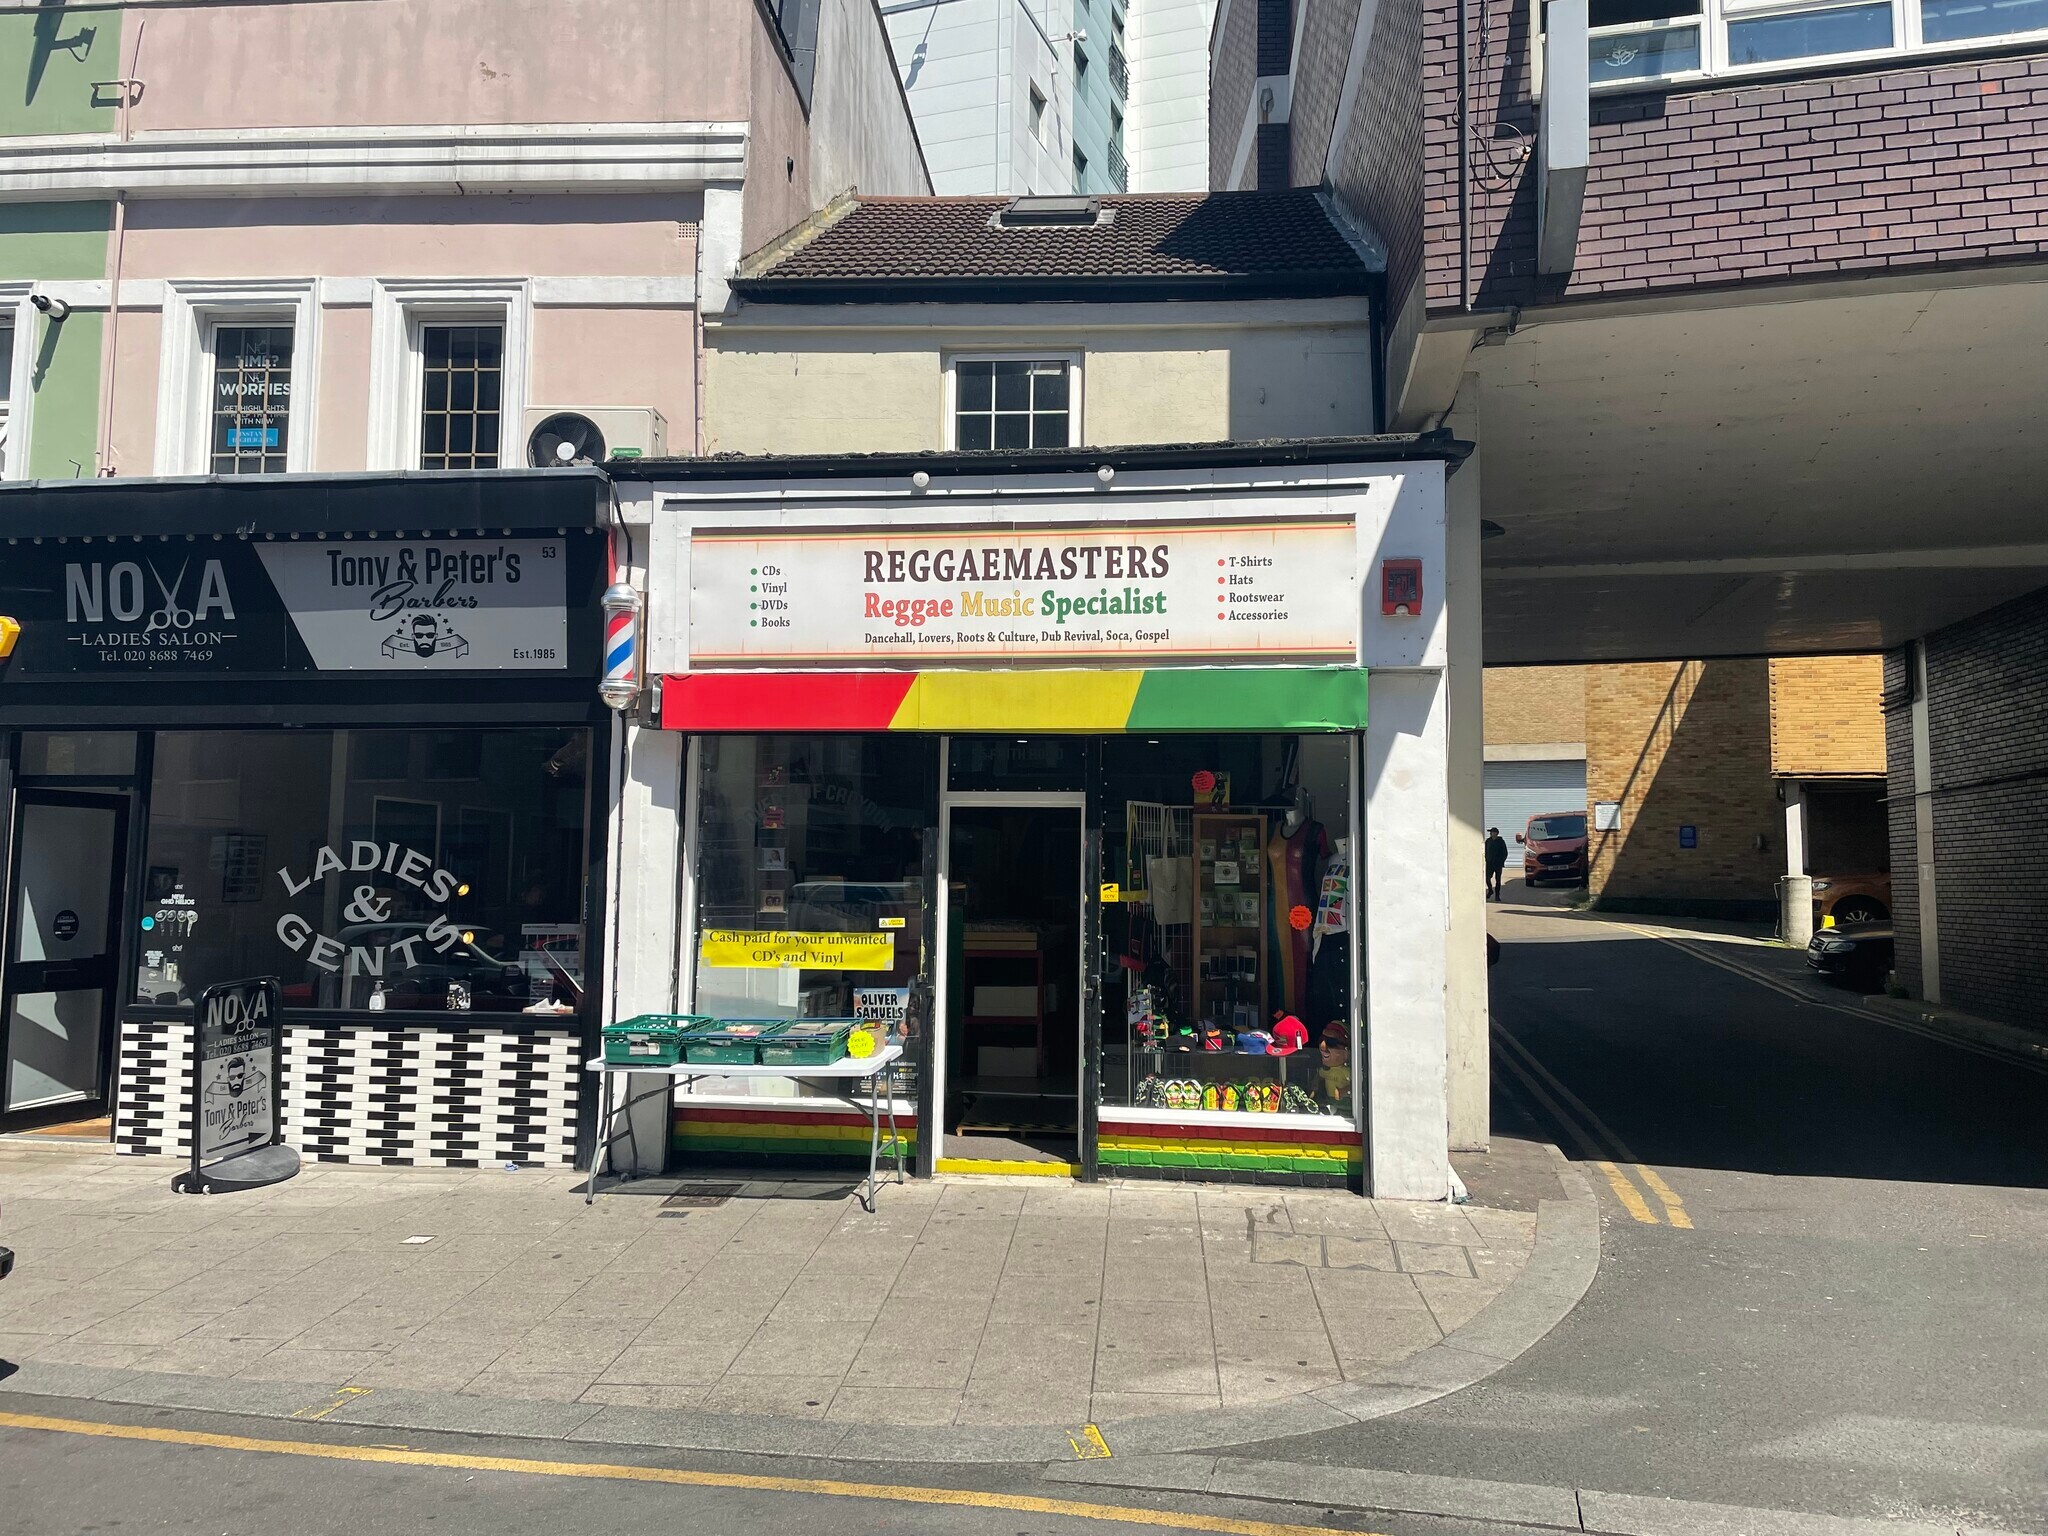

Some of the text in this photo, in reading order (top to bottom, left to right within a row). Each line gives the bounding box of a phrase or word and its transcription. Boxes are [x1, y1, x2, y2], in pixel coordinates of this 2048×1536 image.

[542, 547, 557, 559] 53
[327, 546, 521, 588] Tony & Peter's
[864, 545, 1170, 583] REGGAEMASTERS
[1229, 556, 1273, 568] T-Shirts
[762, 565, 781, 577] CDs
[1229, 574, 1254, 585] Hats
[761, 582, 788, 594] Vinyl
[370, 578, 479, 622] Barbers
[1229, 592, 1285, 603] Rootswear
[761, 600, 788, 611] DVDs
[864, 586, 1167, 627] Reggae Music Specialist
[761, 616, 791, 628] Books
[1229, 610, 1289, 621] Accessories
[82, 631, 222, 646] LADIES SALON
[864, 629, 1170, 645] Dancehall, Lovers, Roots & Culture, Dub Revival, Soca, Gospel
[99, 650, 213, 661] Tel. 020 8688 7469
[277, 840, 460, 903] LADIES
[343, 885, 392, 923] &
[276, 913, 461, 977] GENTS
[709, 930, 888, 948] Cash paid for your unwanted
[752, 950, 844, 966] CD's and Vinyl
[861, 993, 898, 1006] OLIVER
[856, 1006, 904, 1020] SAMUELS
[214, 1032, 259, 1048] LADIES SALON
[251, 1038, 267, 1049] 7469
[204, 1096, 267, 1127] Tony & Peter's
[219, 1111, 254, 1140] Barbers
